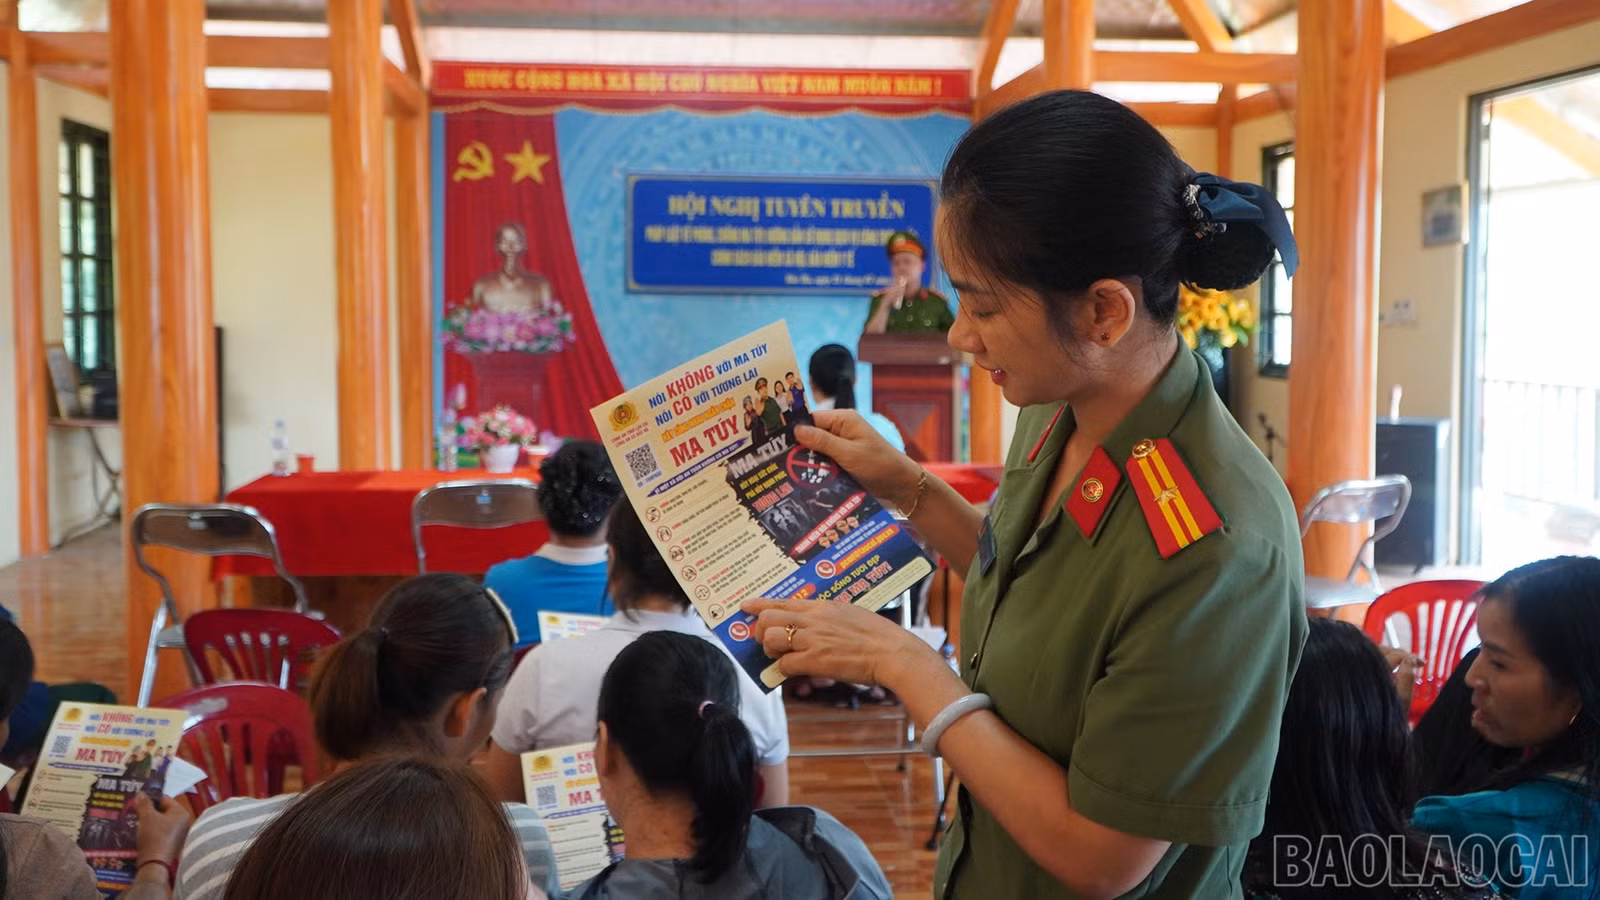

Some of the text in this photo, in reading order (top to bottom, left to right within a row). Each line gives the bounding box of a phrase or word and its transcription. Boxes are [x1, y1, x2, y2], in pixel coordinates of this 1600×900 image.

[668, 189, 905, 222] HỘI NGHỊ TUYÊN TRUYỀN
[649, 343, 768, 408] NÓI KHÔNG VỚI MA TÚY
[655, 367, 758, 426] NÓI CÓ VỚI TƯƠNG LAI
[669, 415, 739, 468] MA TÚY
[728, 433, 788, 479] MA TÚY
[830, 574, 852, 593] SỐNG
[850, 564, 868, 579] TƯƠI
[866, 554, 880, 567] ĐẸP
[848, 577, 870, 596] MA
[568, 790, 593, 806] MA
